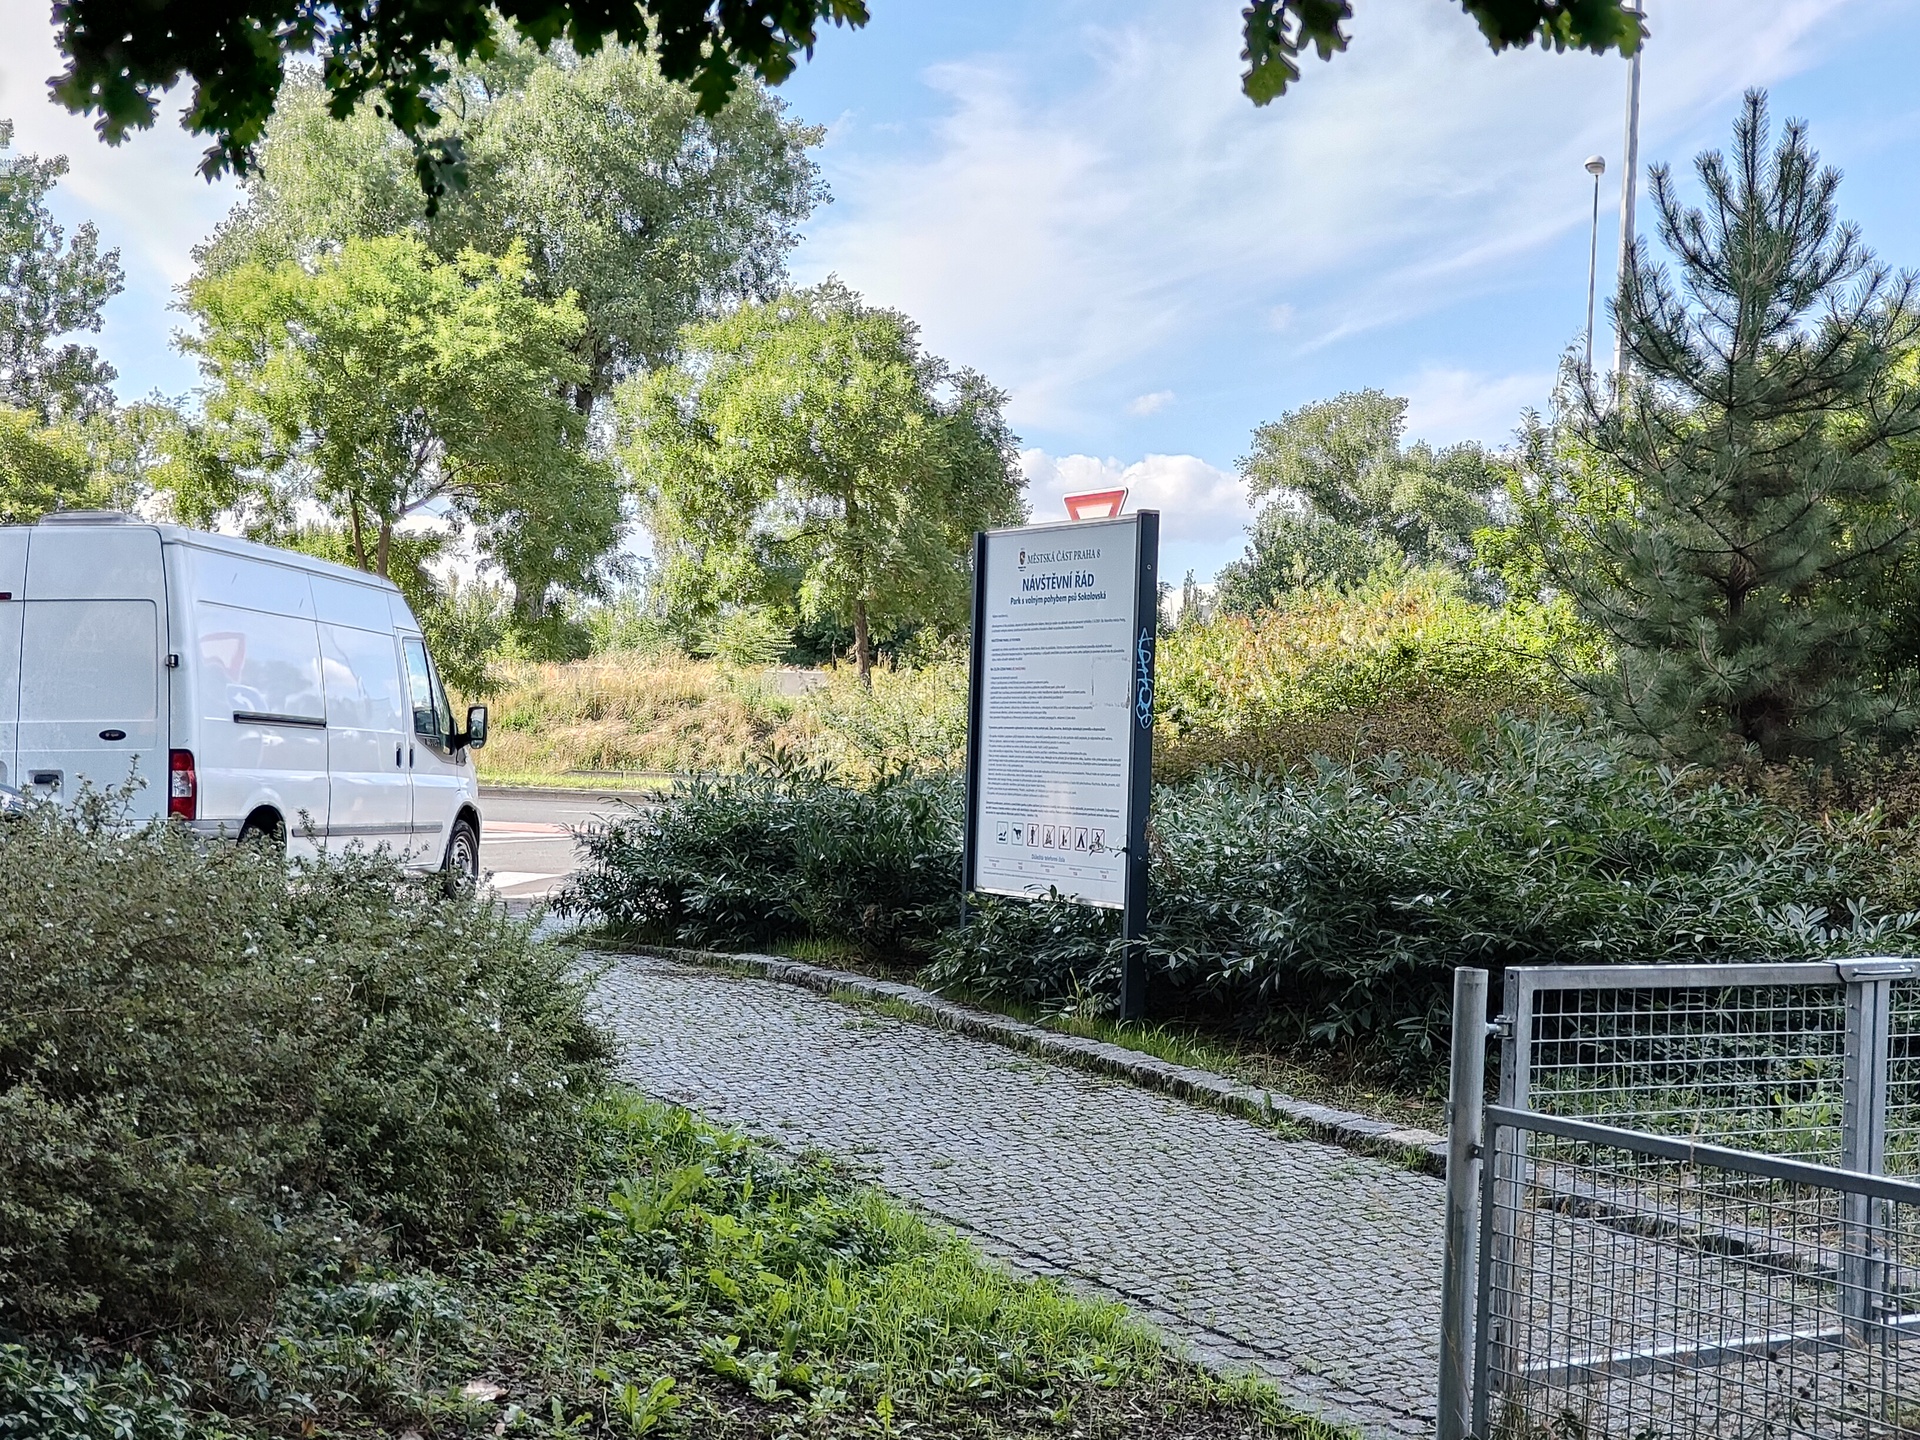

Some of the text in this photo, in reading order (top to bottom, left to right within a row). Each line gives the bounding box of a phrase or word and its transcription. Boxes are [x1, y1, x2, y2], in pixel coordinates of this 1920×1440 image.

[1027, 549, 1101, 564] MĚSTSKÁ ČÁST PRAHA 8
[1022, 570, 1095, 592] NÁVŠTĚVNÍ ŘÁD
[1010, 597, 1021, 605] Park
[1025, 595, 1043, 605] volným
[1043, 594, 1067, 605] pohybem
[1077, 591, 1107, 601] Sokolovská
